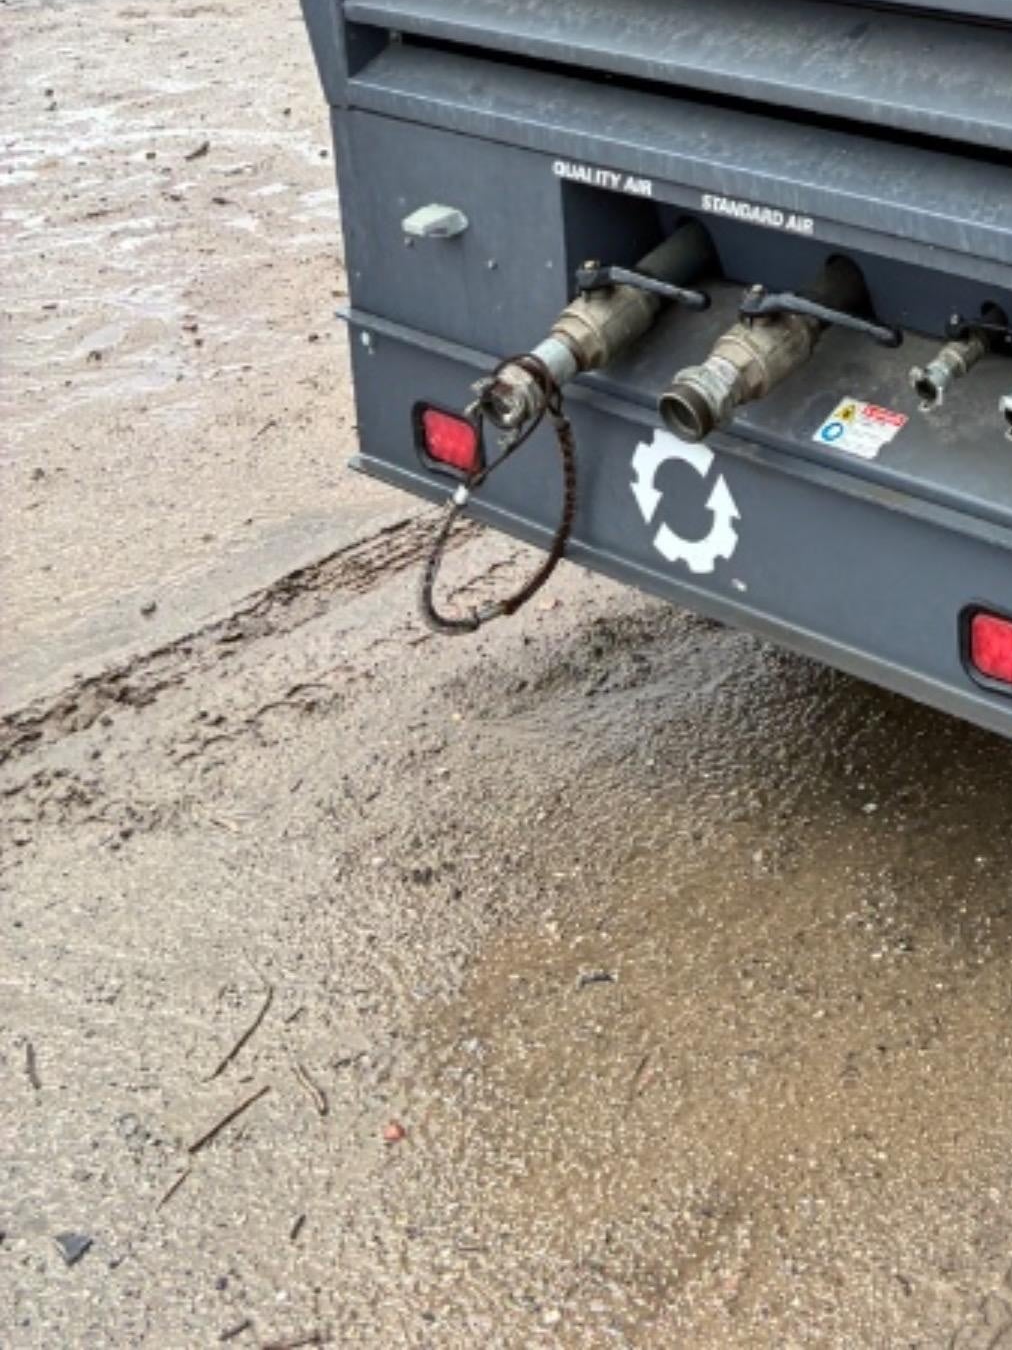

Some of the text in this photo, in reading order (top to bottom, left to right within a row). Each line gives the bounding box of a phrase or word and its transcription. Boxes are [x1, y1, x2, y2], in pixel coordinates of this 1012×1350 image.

[552, 160, 652, 196] QUALITY AIR
[701, 194, 814, 235] STANDARD AIR
